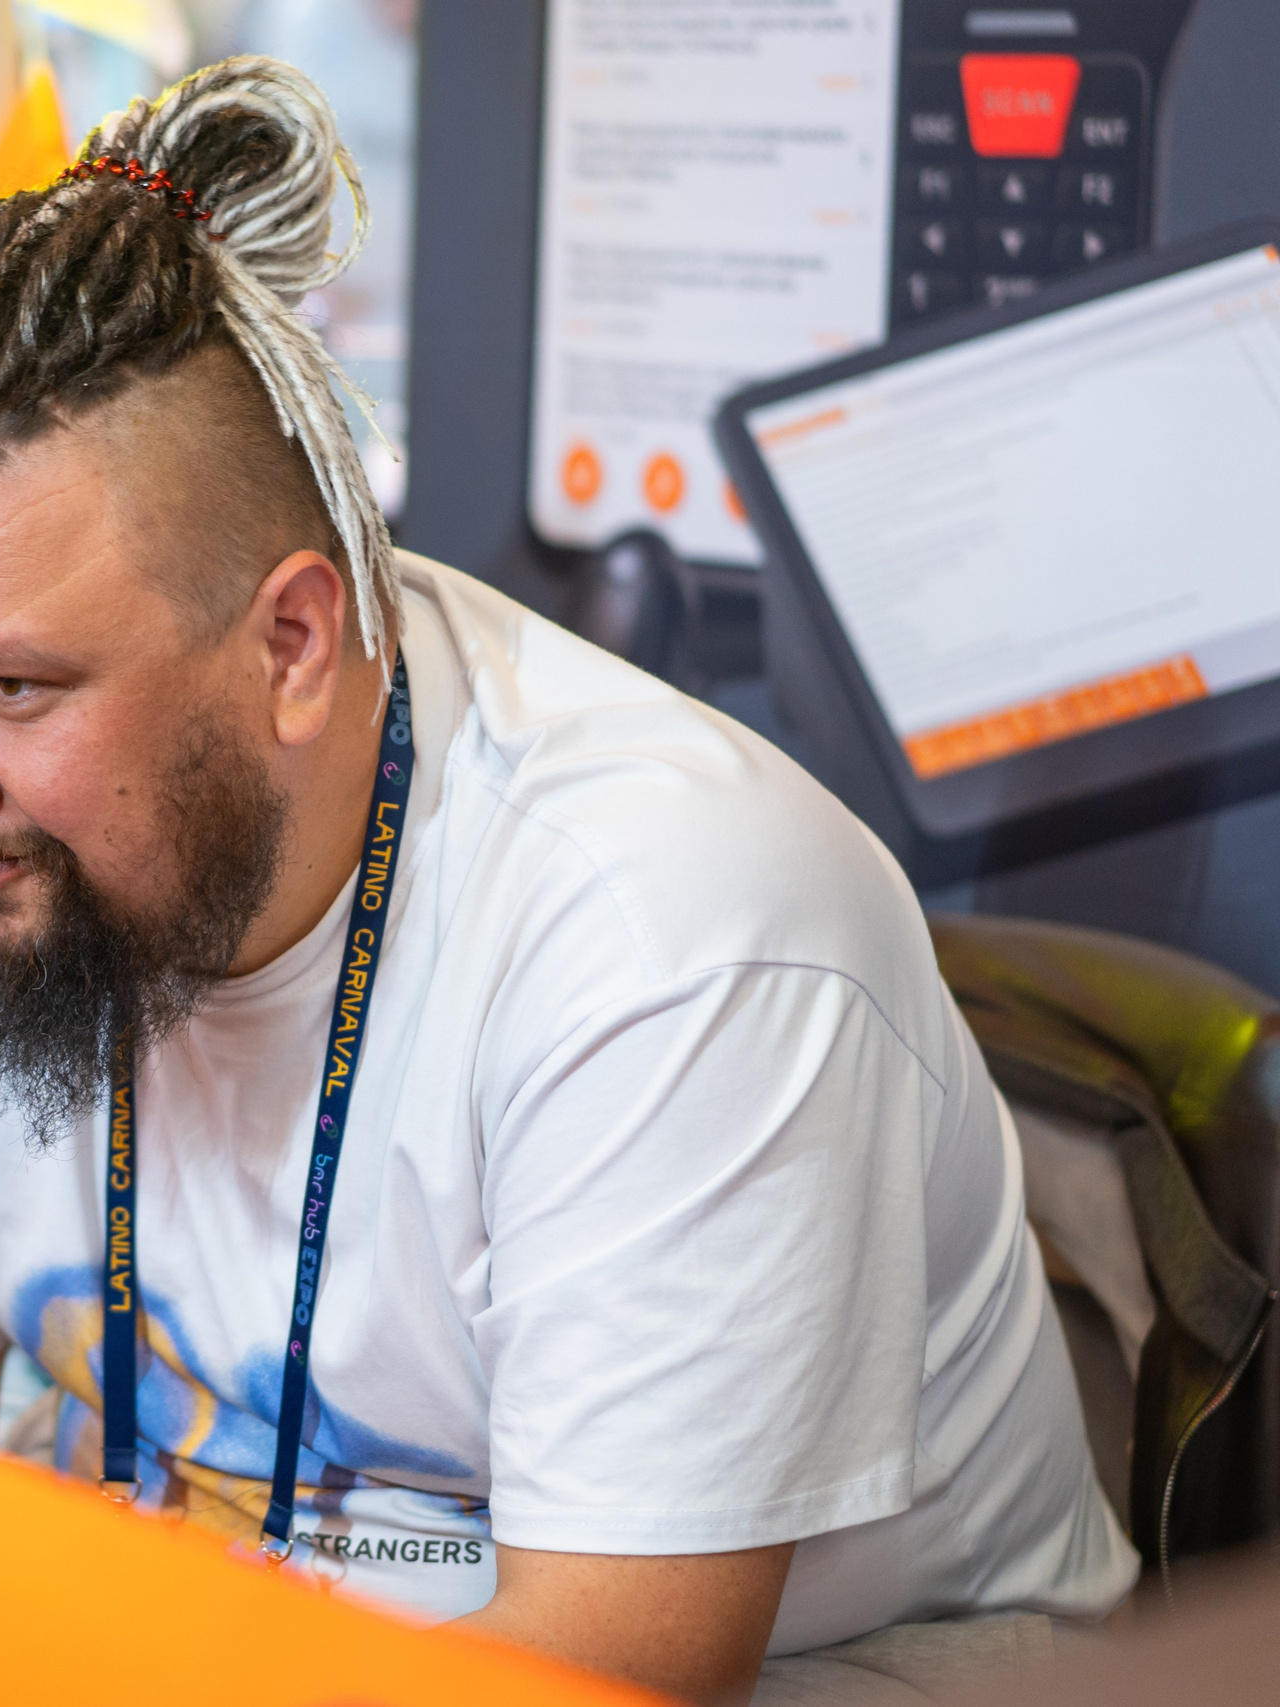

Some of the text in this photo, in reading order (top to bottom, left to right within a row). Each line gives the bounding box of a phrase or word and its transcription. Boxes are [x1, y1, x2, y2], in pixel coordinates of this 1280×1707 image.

[389, 671, 411, 746] EXPO
[325, 801, 400, 1097] LATINO CARNAVAL
[303, 1198, 326, 1241] hub
[109, 1206, 132, 1312] LATINO
[295, 1245, 318, 1326] EXPO
[296, 1531, 483, 1566] STRANGERS
